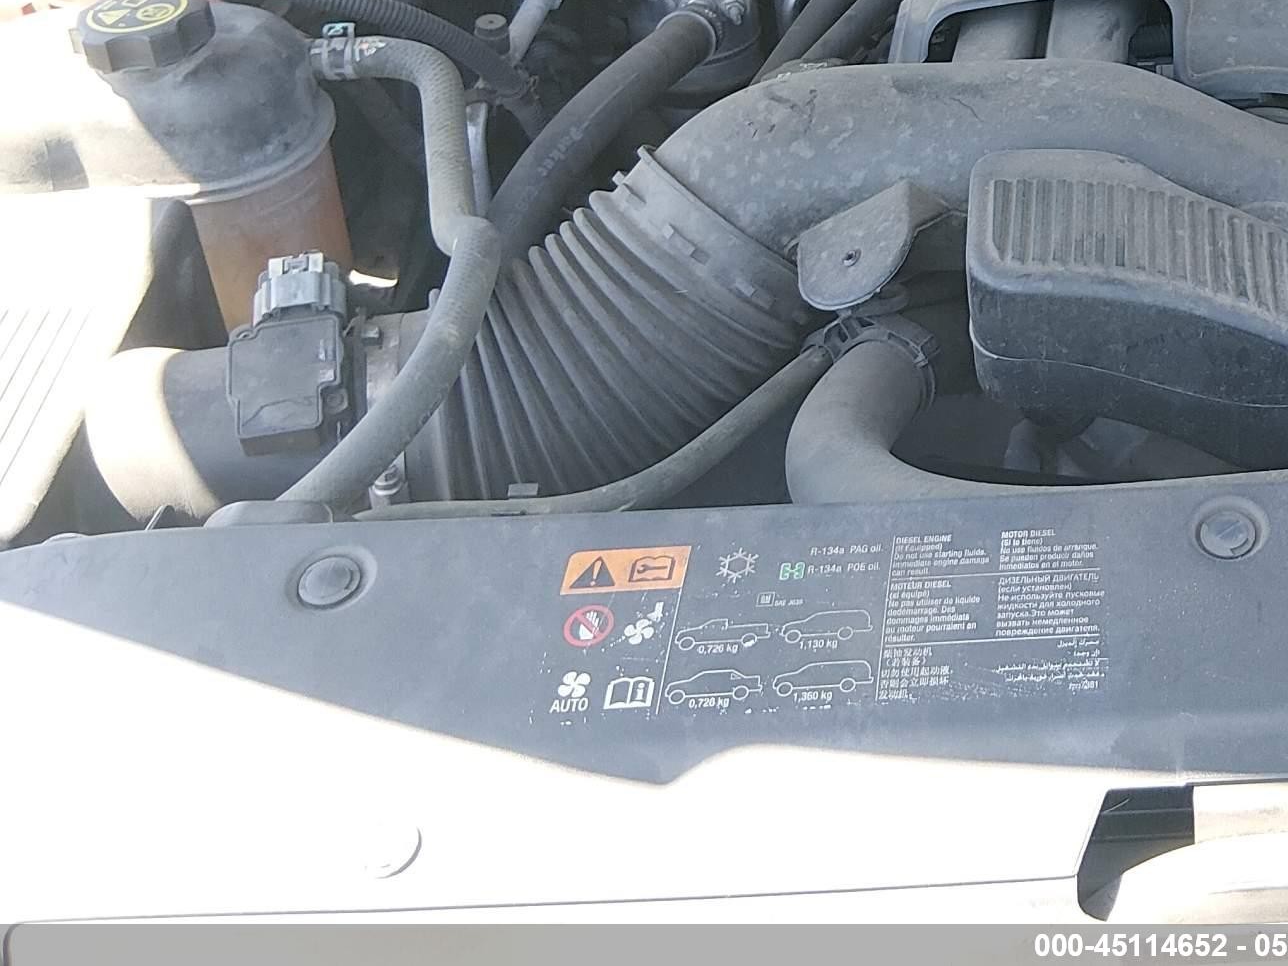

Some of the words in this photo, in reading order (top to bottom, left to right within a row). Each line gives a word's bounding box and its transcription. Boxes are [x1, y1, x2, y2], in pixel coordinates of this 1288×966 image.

[1030, 529, 1056, 537] DIESEL
[896, 536, 921, 544] DIESEL
[811, 546, 844, 556] R-134a
[850, 545, 868, 554] PAG
[935, 550, 962, 558] starting
[934, 558, 958, 567] engine
[960, 557, 989, 565] damage
[808, 564, 841, 574] R-134a
[848, 563, 865, 571] POE
[891, 582, 922, 590] MOTEUR
[925, 580, 951, 588] DIESEL
[726, 643, 738, 654] kg
[800, 639, 824, 650] 1,130
[826, 638, 837, 649] kg
[821, 690, 833, 702] kg
[549, 698, 588, 713] AUTO
[717, 697, 729, 708] kg
